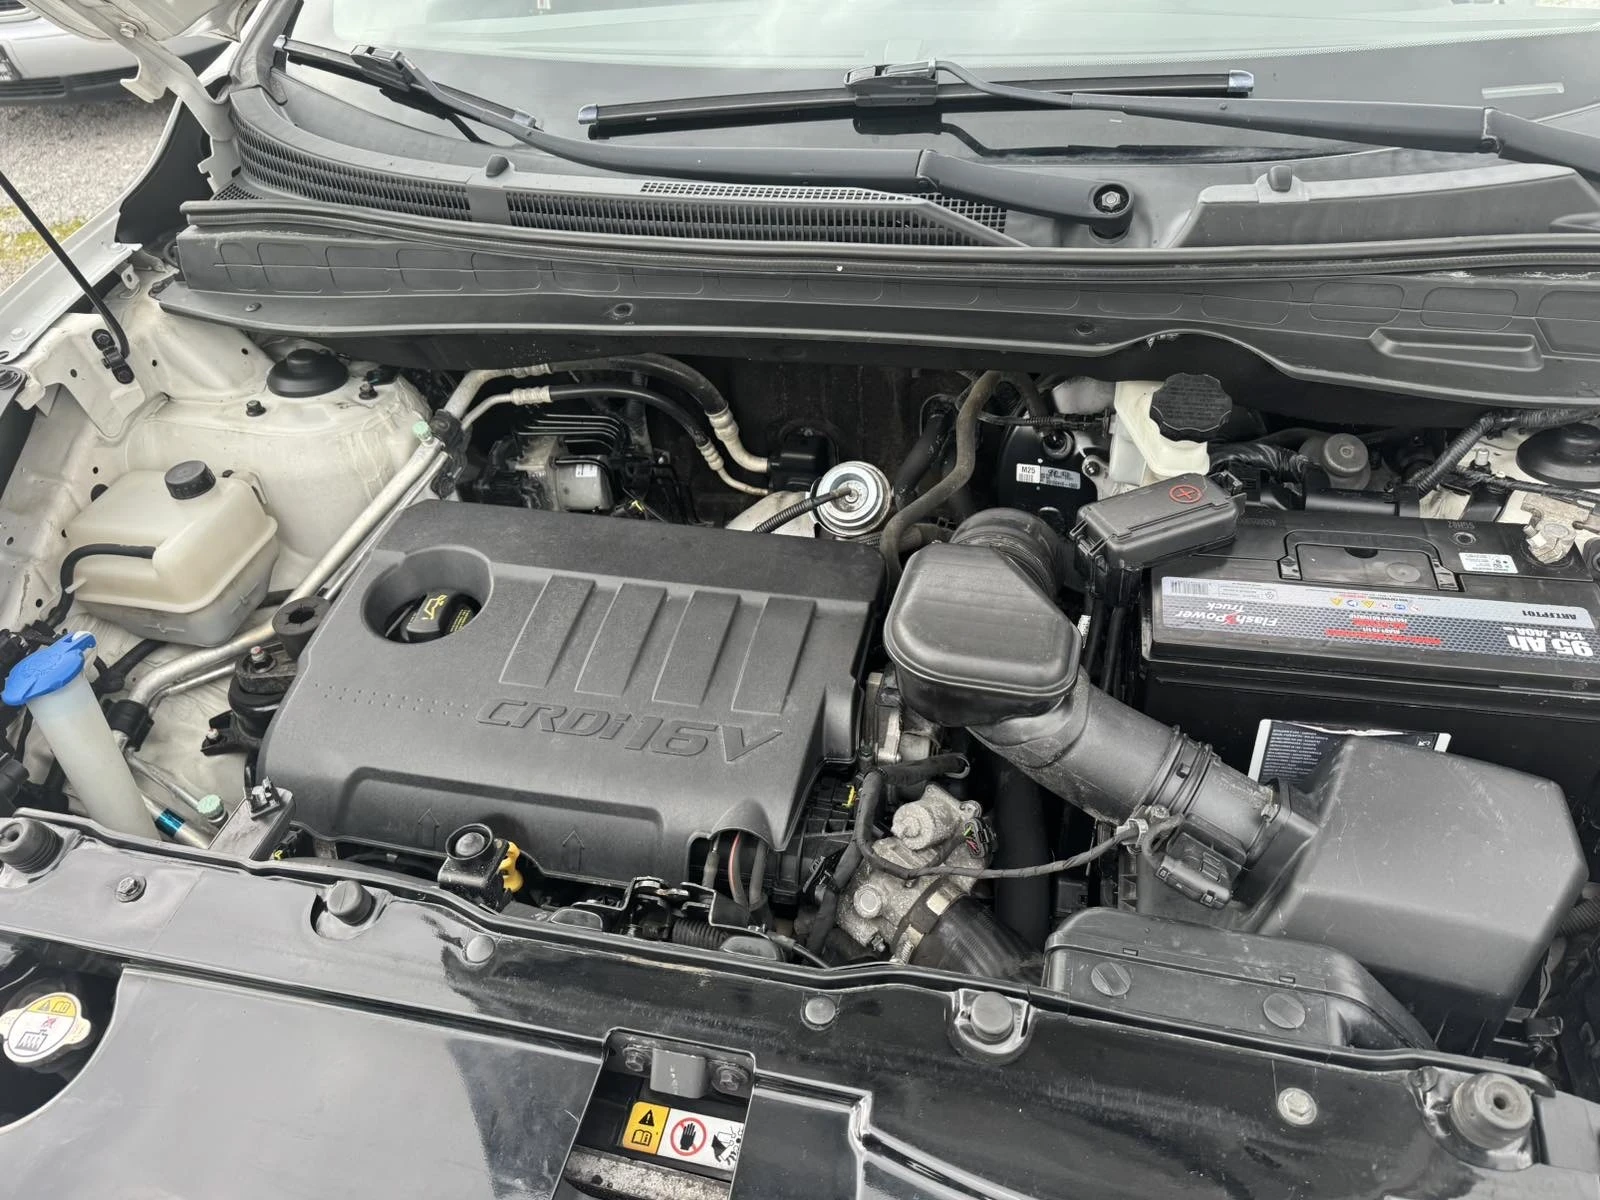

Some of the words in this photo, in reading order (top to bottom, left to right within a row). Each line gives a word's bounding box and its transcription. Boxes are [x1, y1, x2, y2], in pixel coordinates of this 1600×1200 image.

[1021, 465, 1036, 474] M25
[1206, 602, 1245, 613] Truck
[1175, 610, 1227, 622] Power
[1235, 614, 1279, 627] Flash
[1560, 630, 1585, 641] 12V
[1507, 634, 1547, 653] Ah
[1551, 638, 1594, 657] 95
